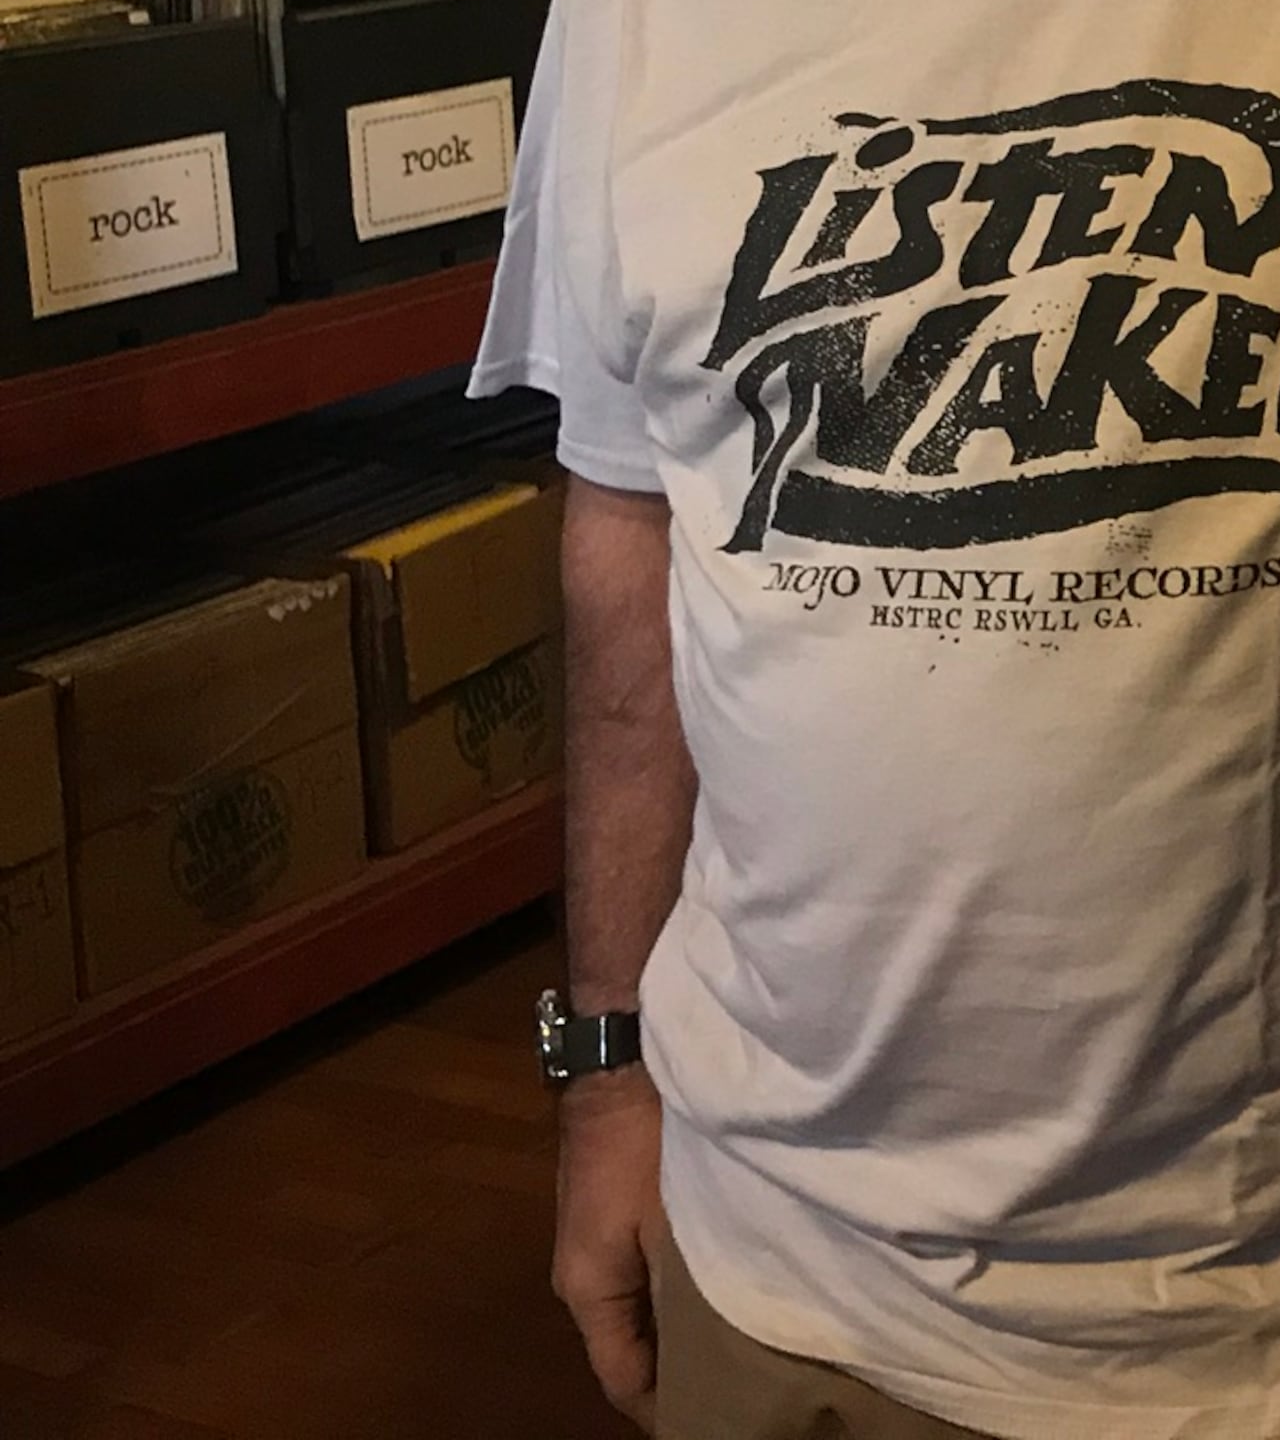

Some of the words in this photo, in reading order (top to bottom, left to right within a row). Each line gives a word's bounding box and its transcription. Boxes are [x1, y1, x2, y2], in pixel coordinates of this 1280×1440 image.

[402, 135, 475, 178] rock
[89, 195, 180, 243] rock
[761, 563, 862, 610] MOJO
[875, 566, 1034, 605] VINYL
[870, 605, 962, 629] HSTRC
[974, 606, 1079, 631] RSWLL
[1094, 606, 1142, 630] GA.
